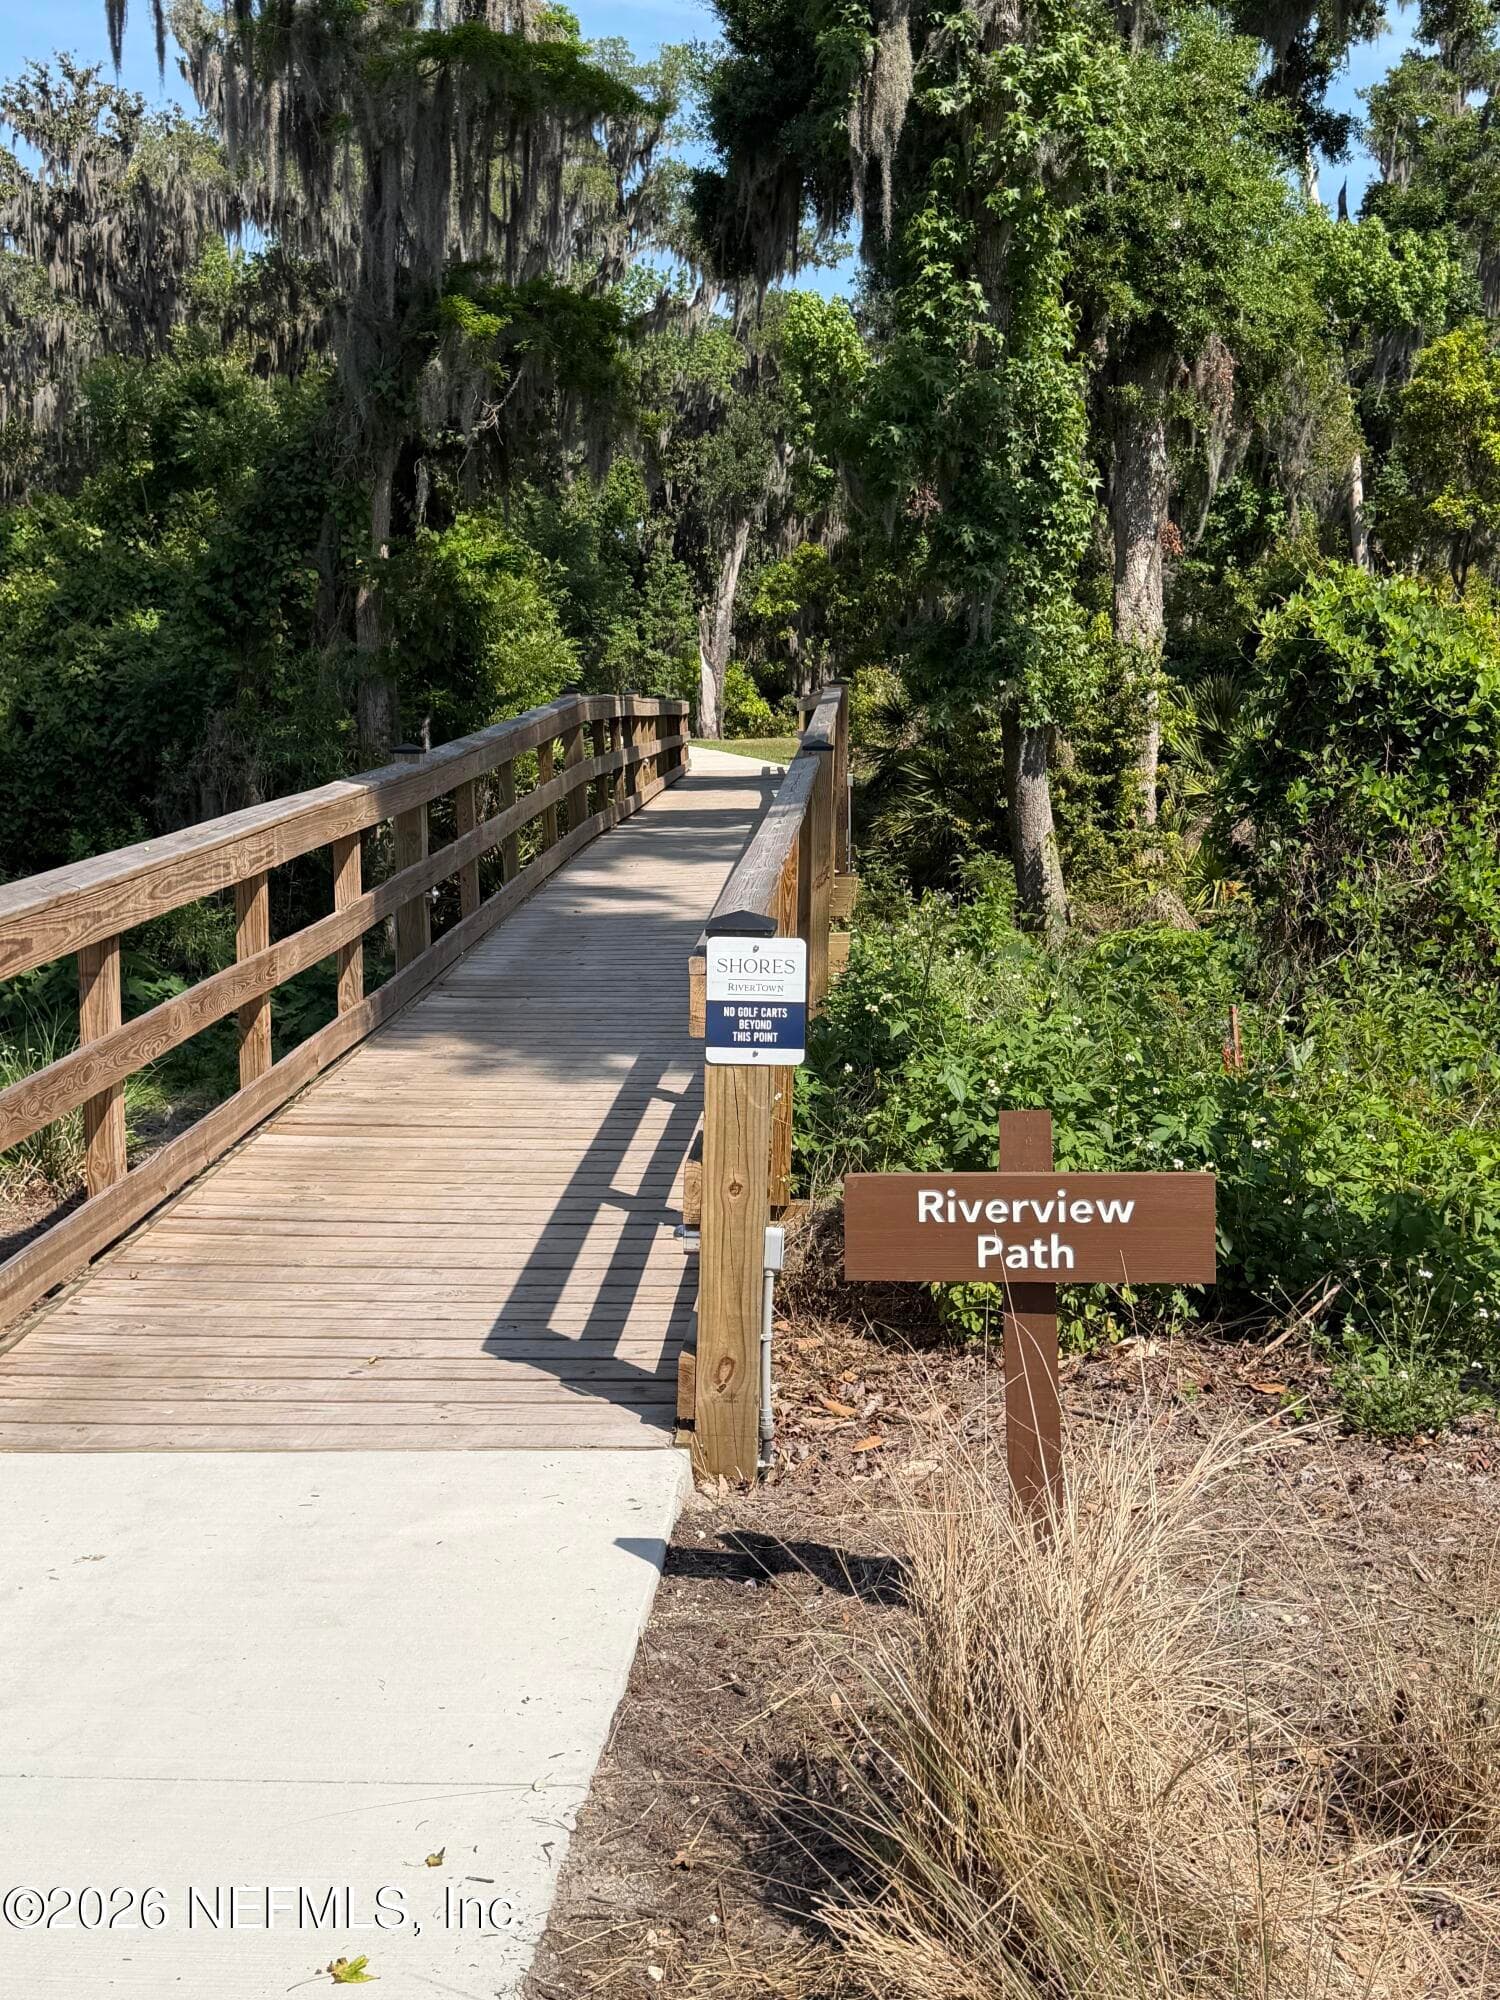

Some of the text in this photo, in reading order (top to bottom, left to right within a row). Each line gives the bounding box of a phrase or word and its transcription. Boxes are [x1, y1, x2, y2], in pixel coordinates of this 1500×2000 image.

[716, 958, 796, 975] SHORES
[723, 1006, 788, 1018] NO GOLF CARTS
[738, 1019, 772, 1030] BEYOND
[732, 1031, 779, 1043] THIS POINT
[917, 1188, 1136, 1224] Riverview
[977, 1233, 1075, 1269] Path
